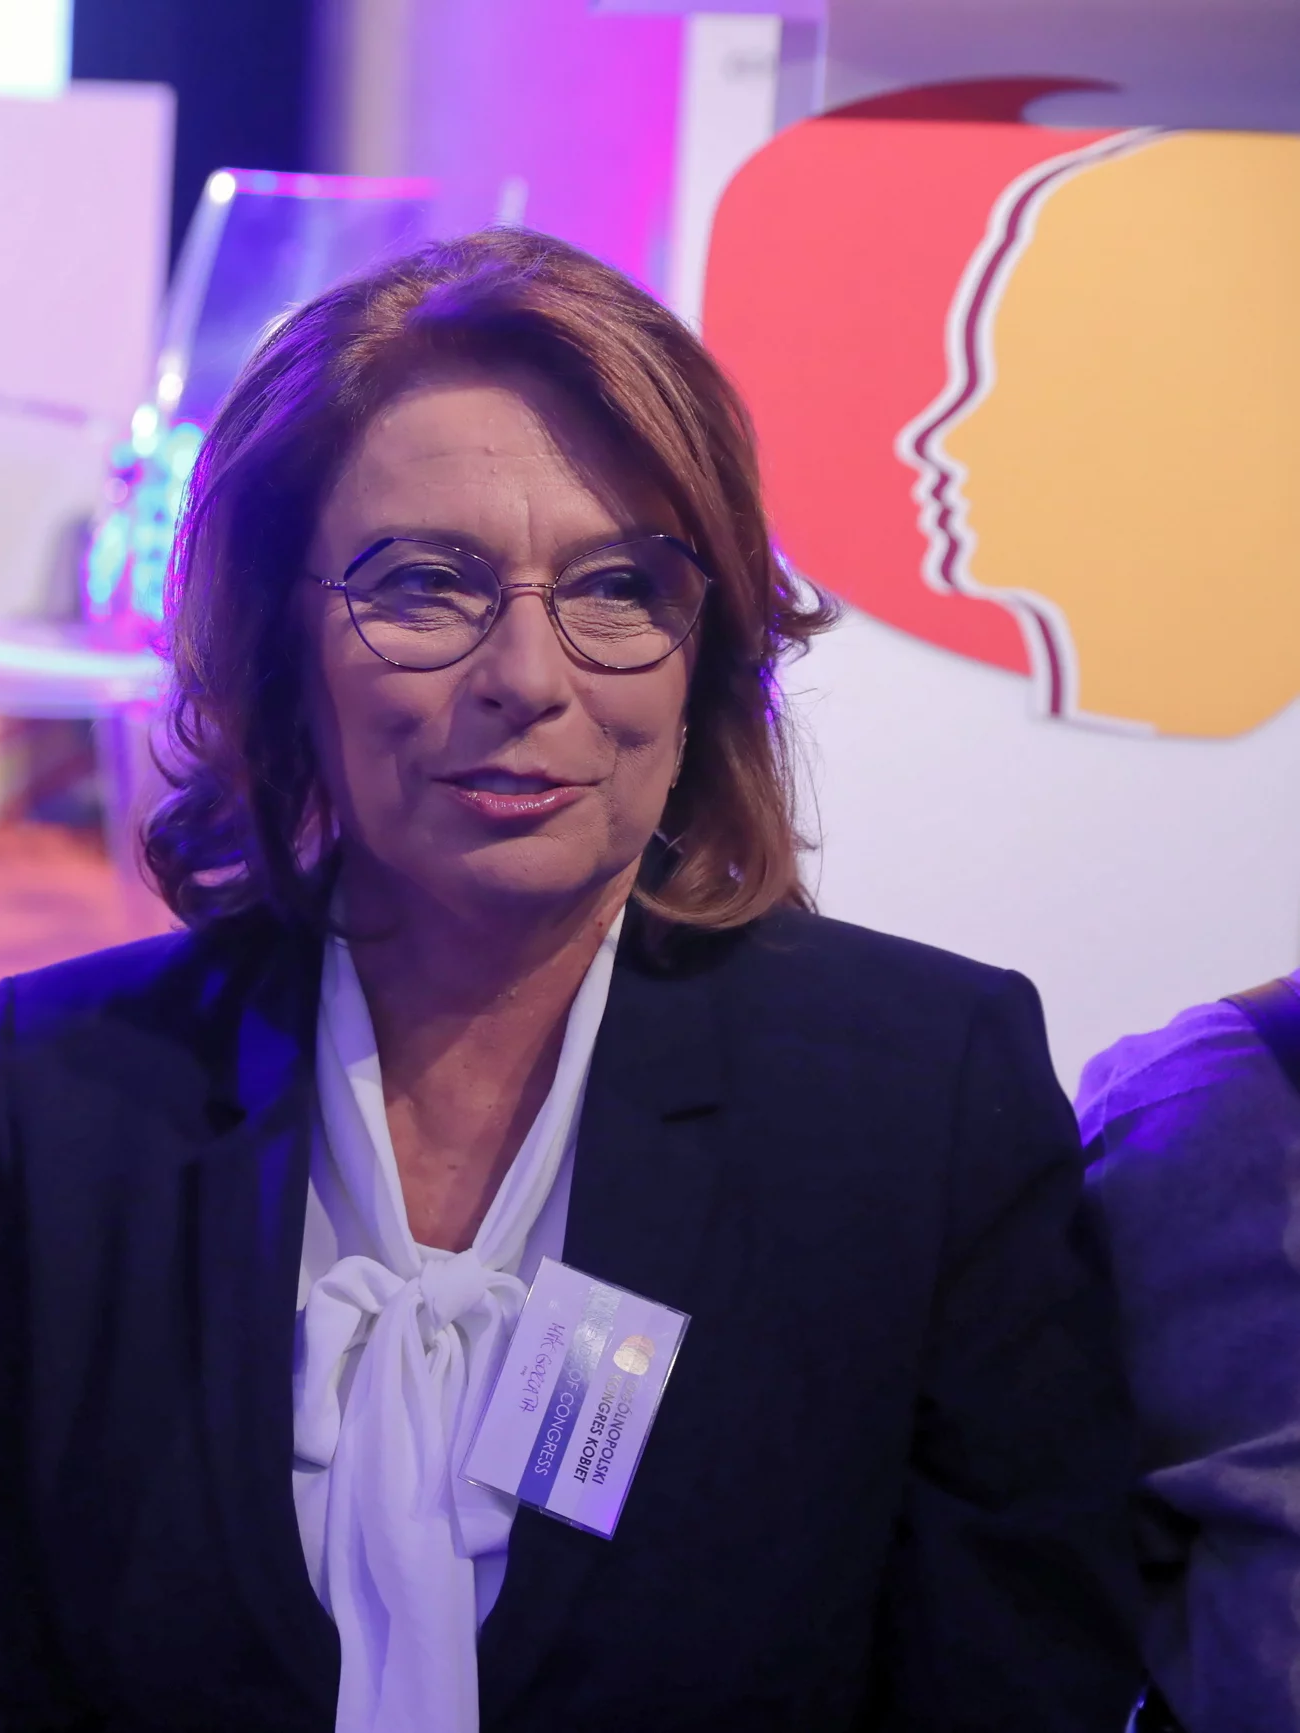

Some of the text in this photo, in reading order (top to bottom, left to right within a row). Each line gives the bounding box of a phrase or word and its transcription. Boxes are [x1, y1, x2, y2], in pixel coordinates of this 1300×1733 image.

[564, 1367, 584, 1390] OF
[532, 1390, 575, 1476] CONGRESS
[572, 1372, 622, 1483] KONGRES KOBIET
